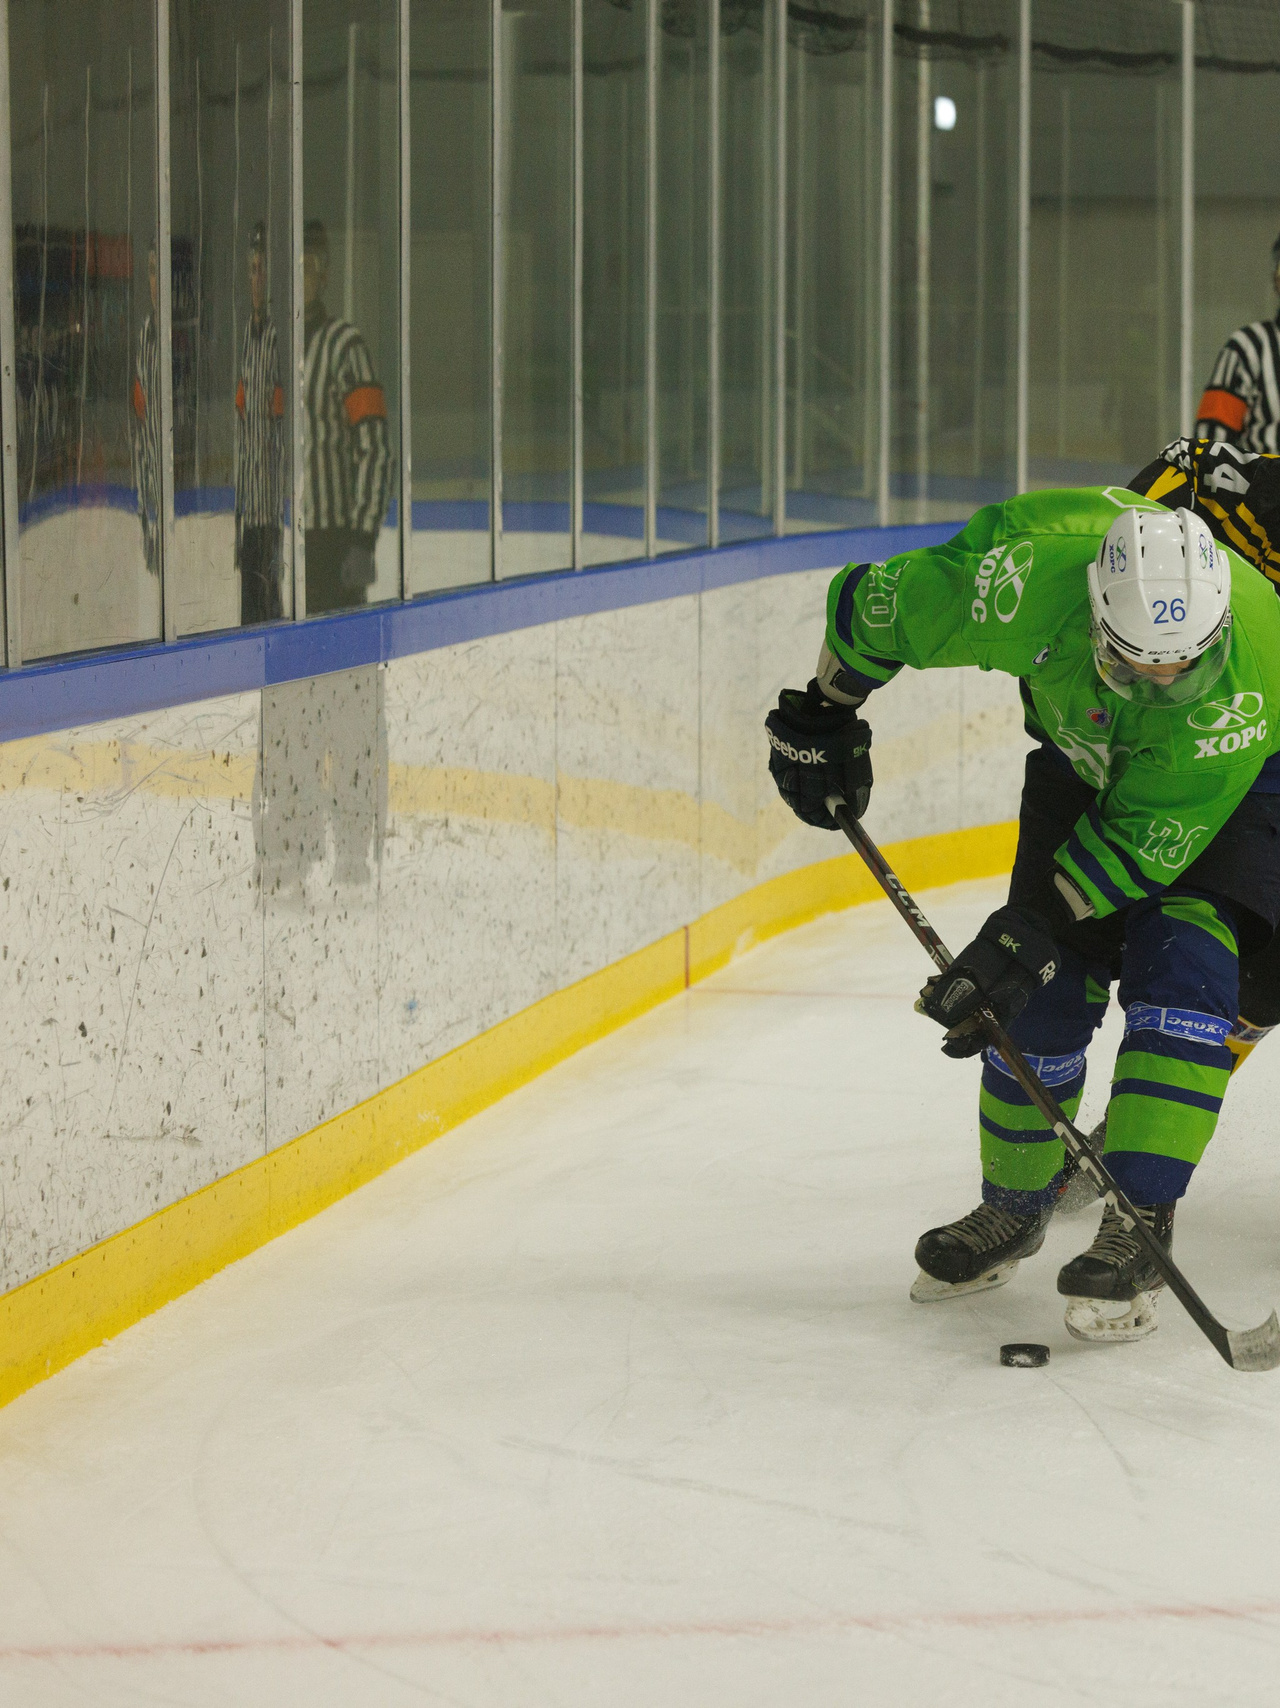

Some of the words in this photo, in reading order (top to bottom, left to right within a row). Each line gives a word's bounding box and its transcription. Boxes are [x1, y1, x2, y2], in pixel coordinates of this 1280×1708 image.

[1203, 441, 1261, 495] 24
[1151, 597, 1187, 625] 26
[765, 725, 829, 765] Reebok
[1193, 719, 1267, 760] ХОРС
